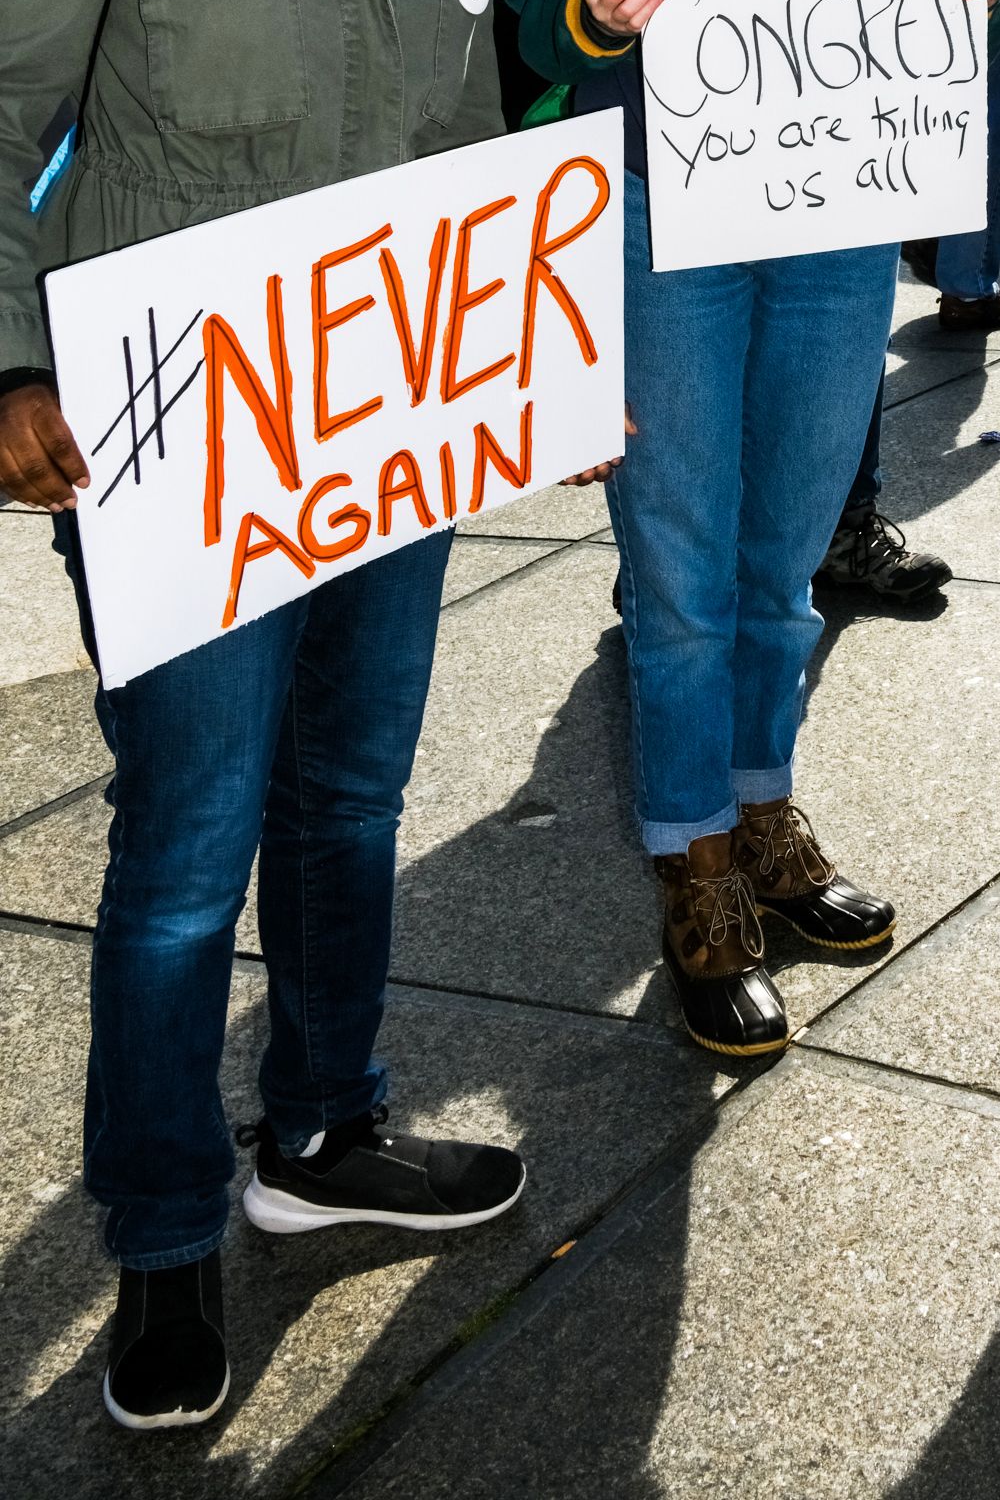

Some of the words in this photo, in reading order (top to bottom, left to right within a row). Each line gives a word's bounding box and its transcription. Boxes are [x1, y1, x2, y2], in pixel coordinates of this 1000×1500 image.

[778, 116, 852, 149] are
[856, 141, 918, 195] all
[91, 155, 611, 546] #NEVER
[221, 401, 534, 628] AGAIN
